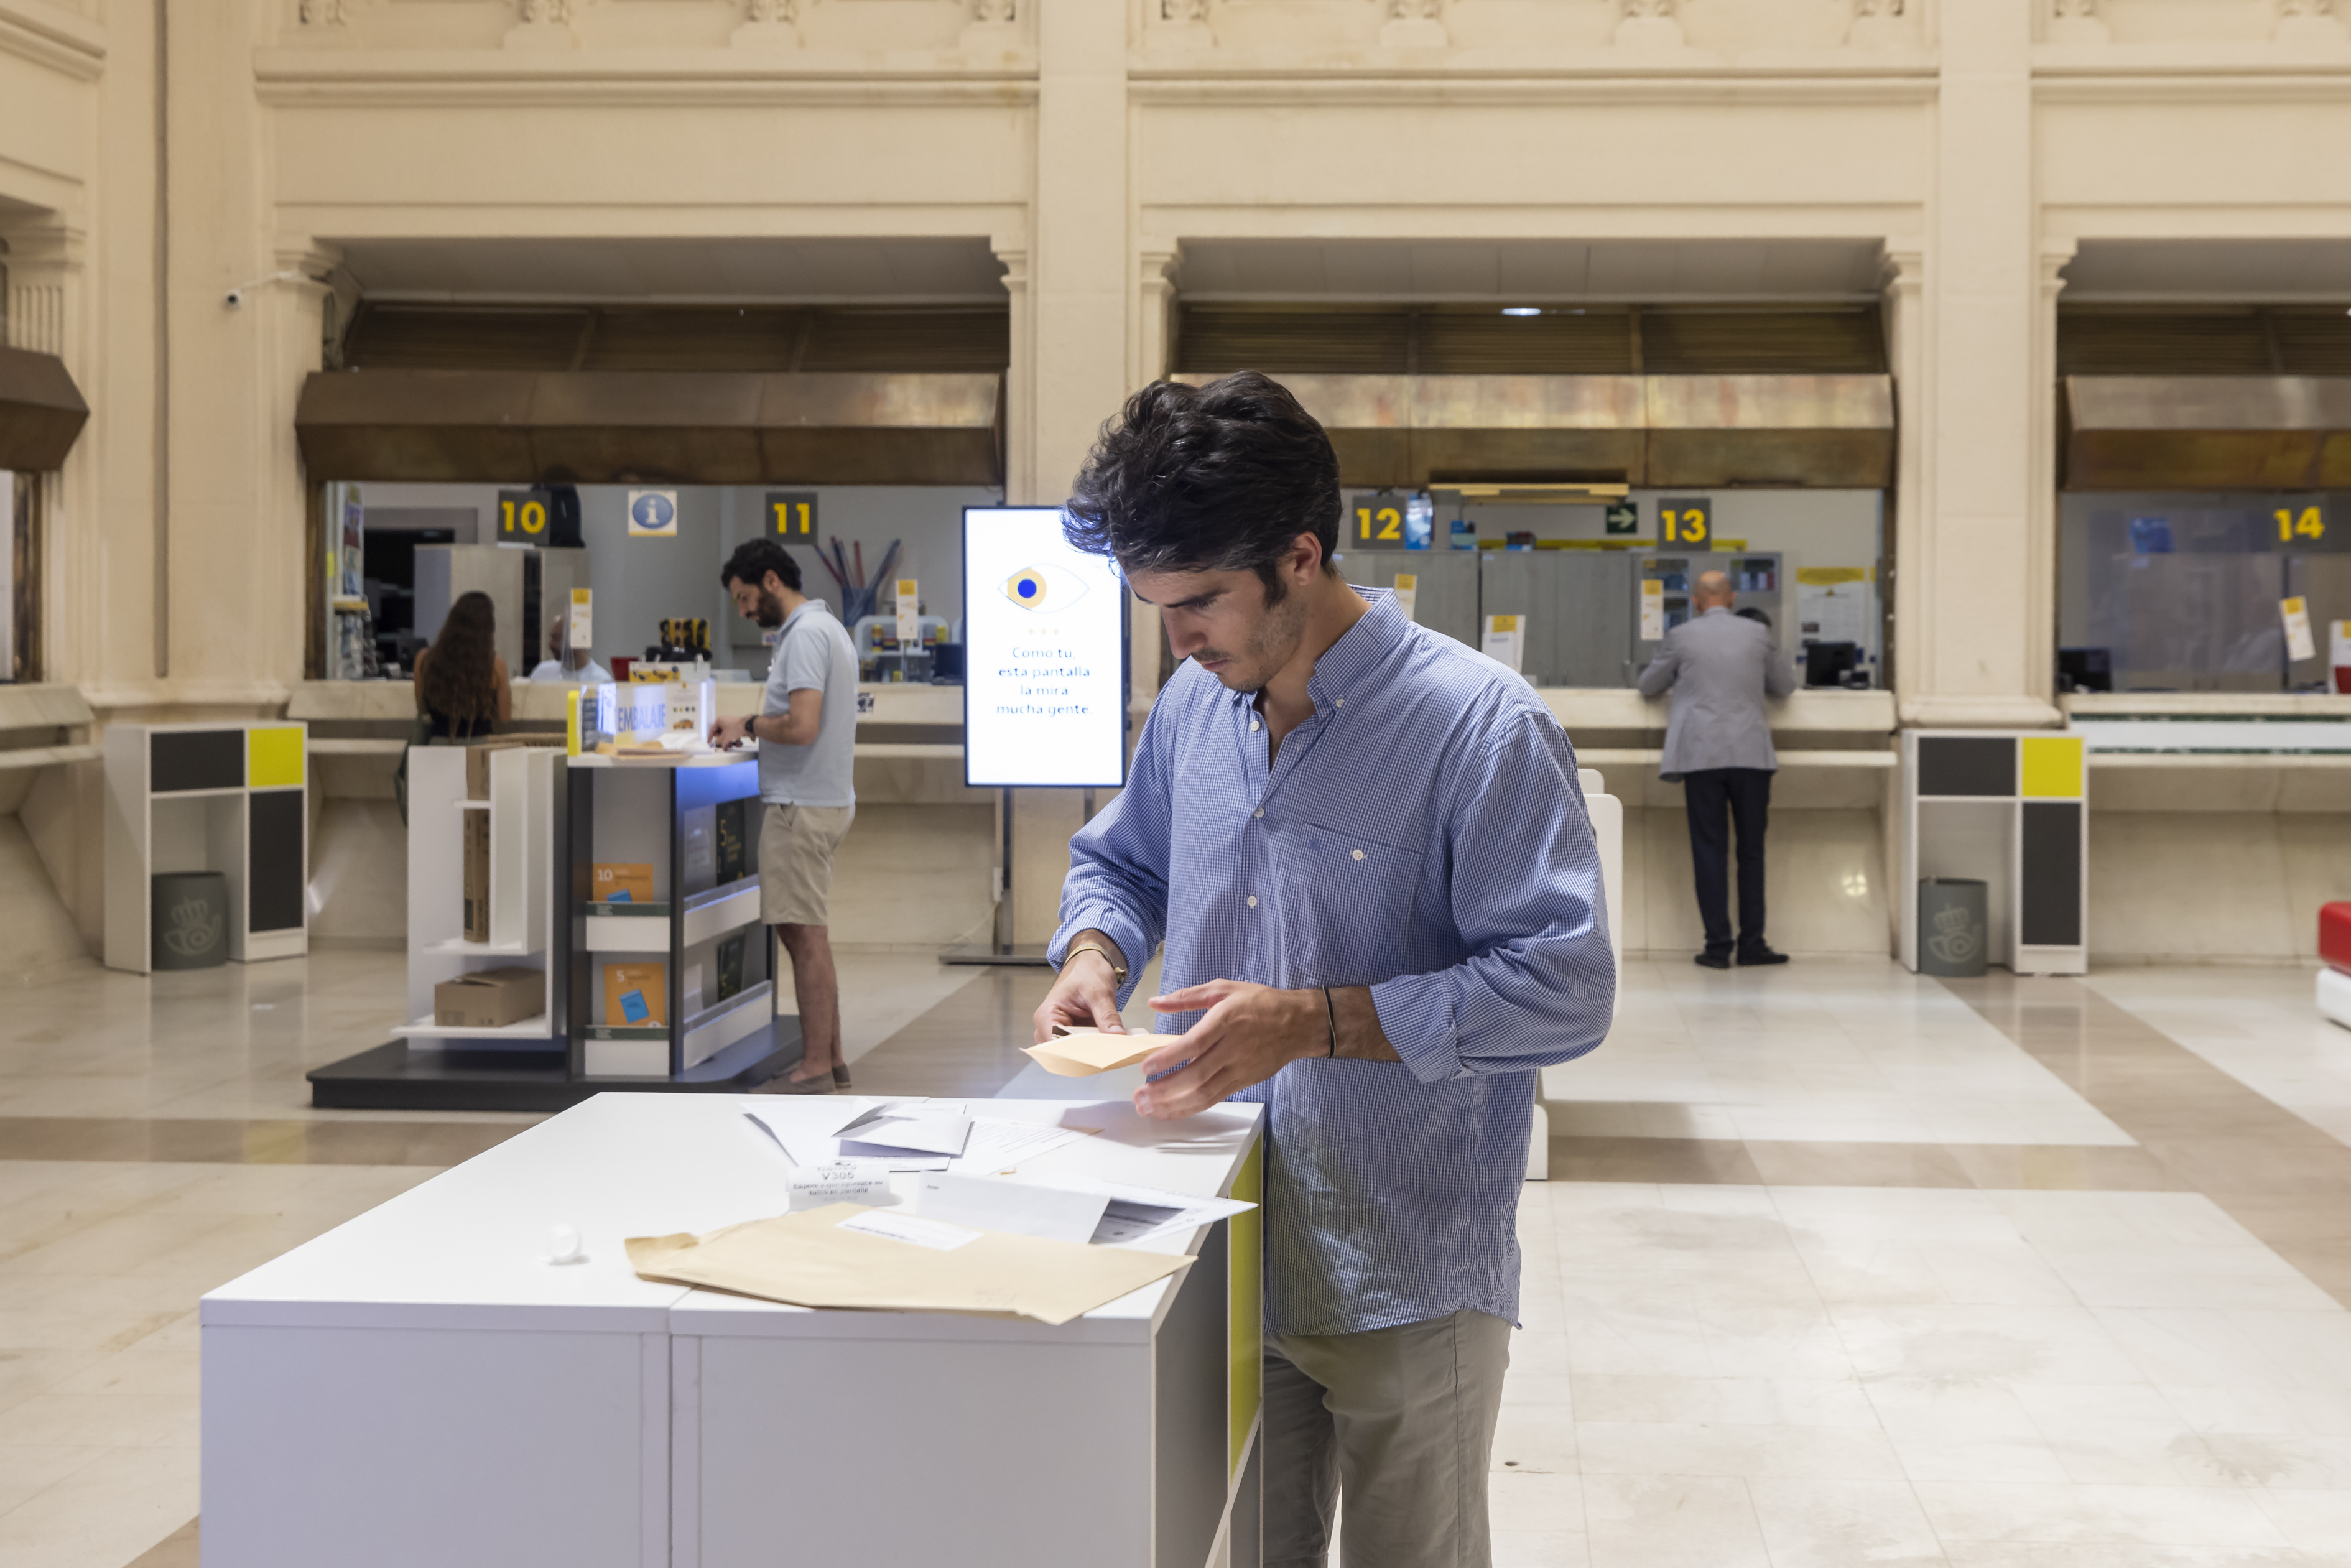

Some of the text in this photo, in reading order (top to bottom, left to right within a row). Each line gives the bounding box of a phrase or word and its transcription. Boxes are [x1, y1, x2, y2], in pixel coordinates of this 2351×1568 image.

[502, 500, 546, 534] 10
[773, 503, 810, 534] 11
[1356, 507, 1401, 540] 12
[1661, 508, 1707, 543] 13
[2274, 506, 2325, 542] 14
[1012, 647, 1053, 659] Como
[998, 666, 1090, 680] esta pantalla
[1021, 685, 1068, 695] la mira
[618, 703, 666, 733] EMBALAJE
[996, 703, 1043, 714] mucha
[596, 868, 613, 883] 10
[822, 1171, 855, 1181] V305
